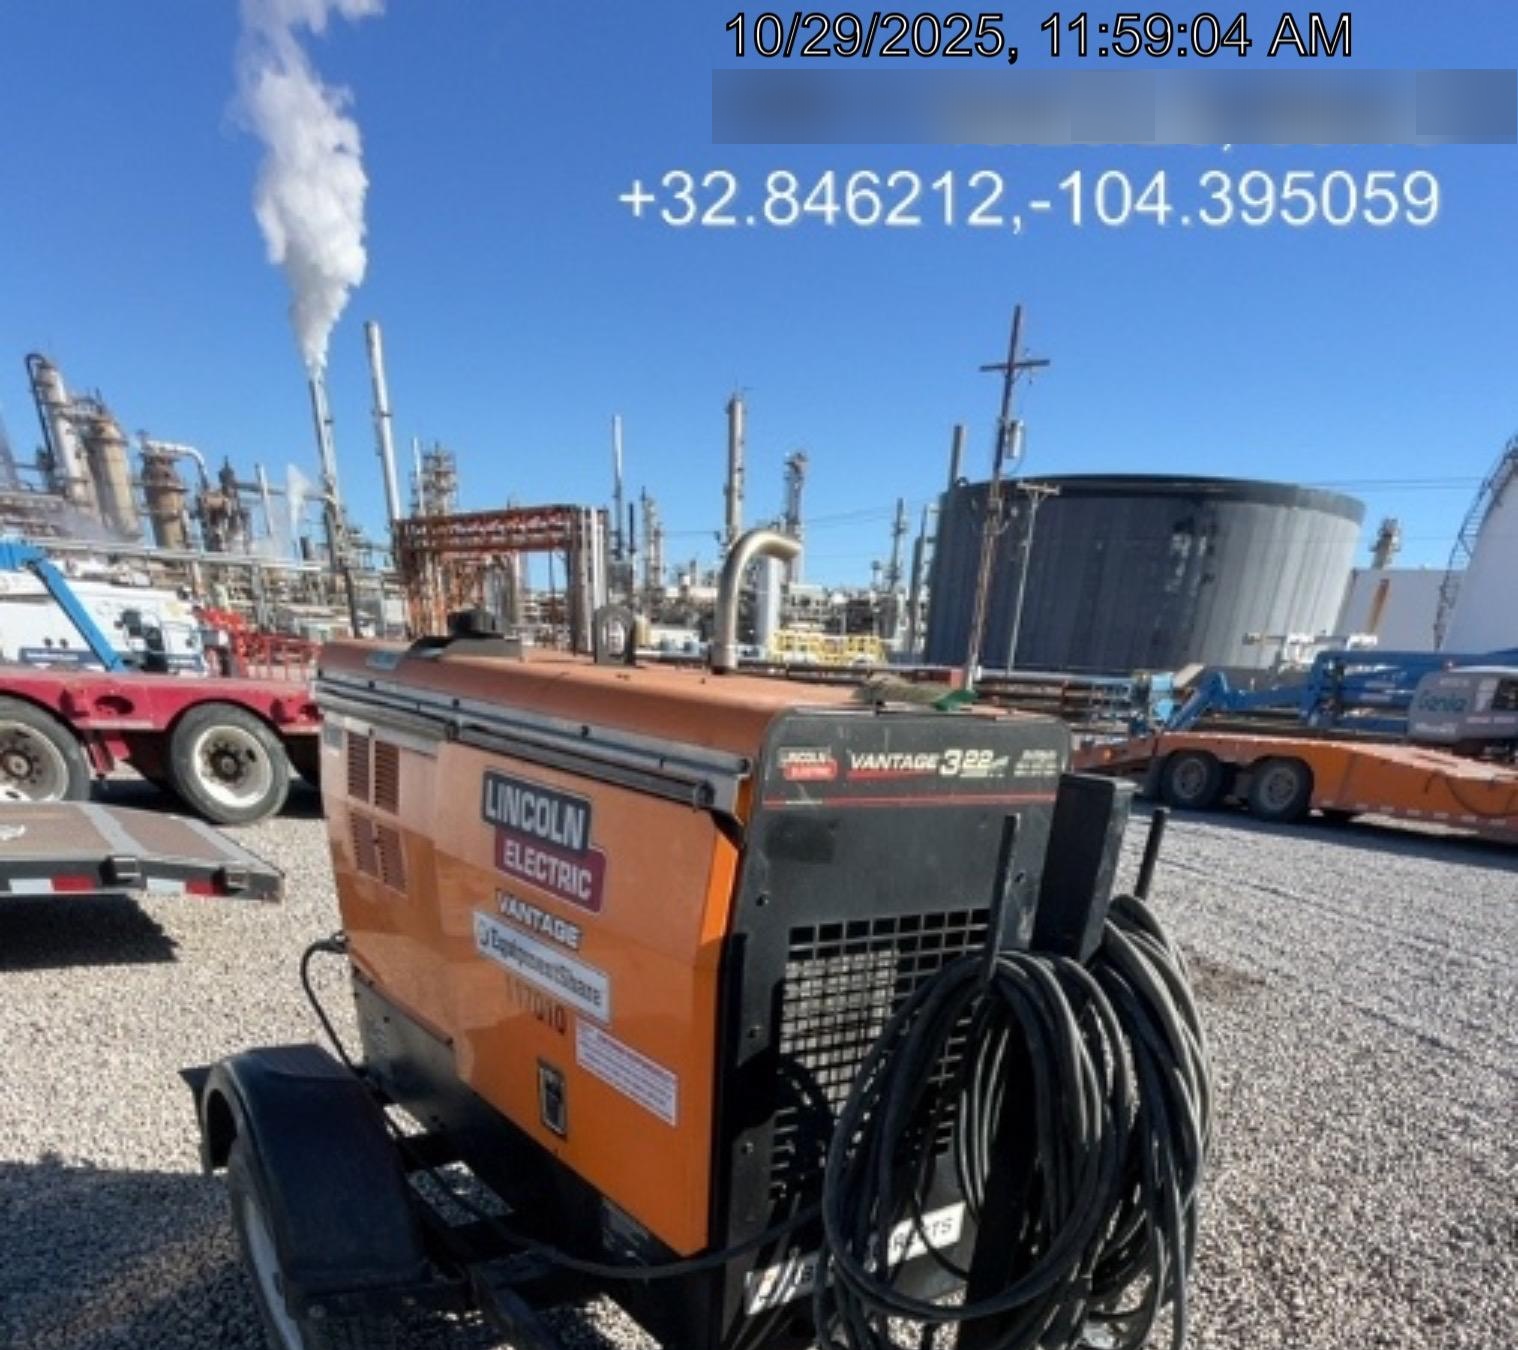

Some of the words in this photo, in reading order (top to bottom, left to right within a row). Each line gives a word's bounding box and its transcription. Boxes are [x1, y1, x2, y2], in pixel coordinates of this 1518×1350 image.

[851, 752, 938, 770] VANTAGE
[485, 779, 585, 850] LINCOLN
[503, 839, 592, 900] ELECTRIC
[496, 890, 580, 949] VANTAGE
